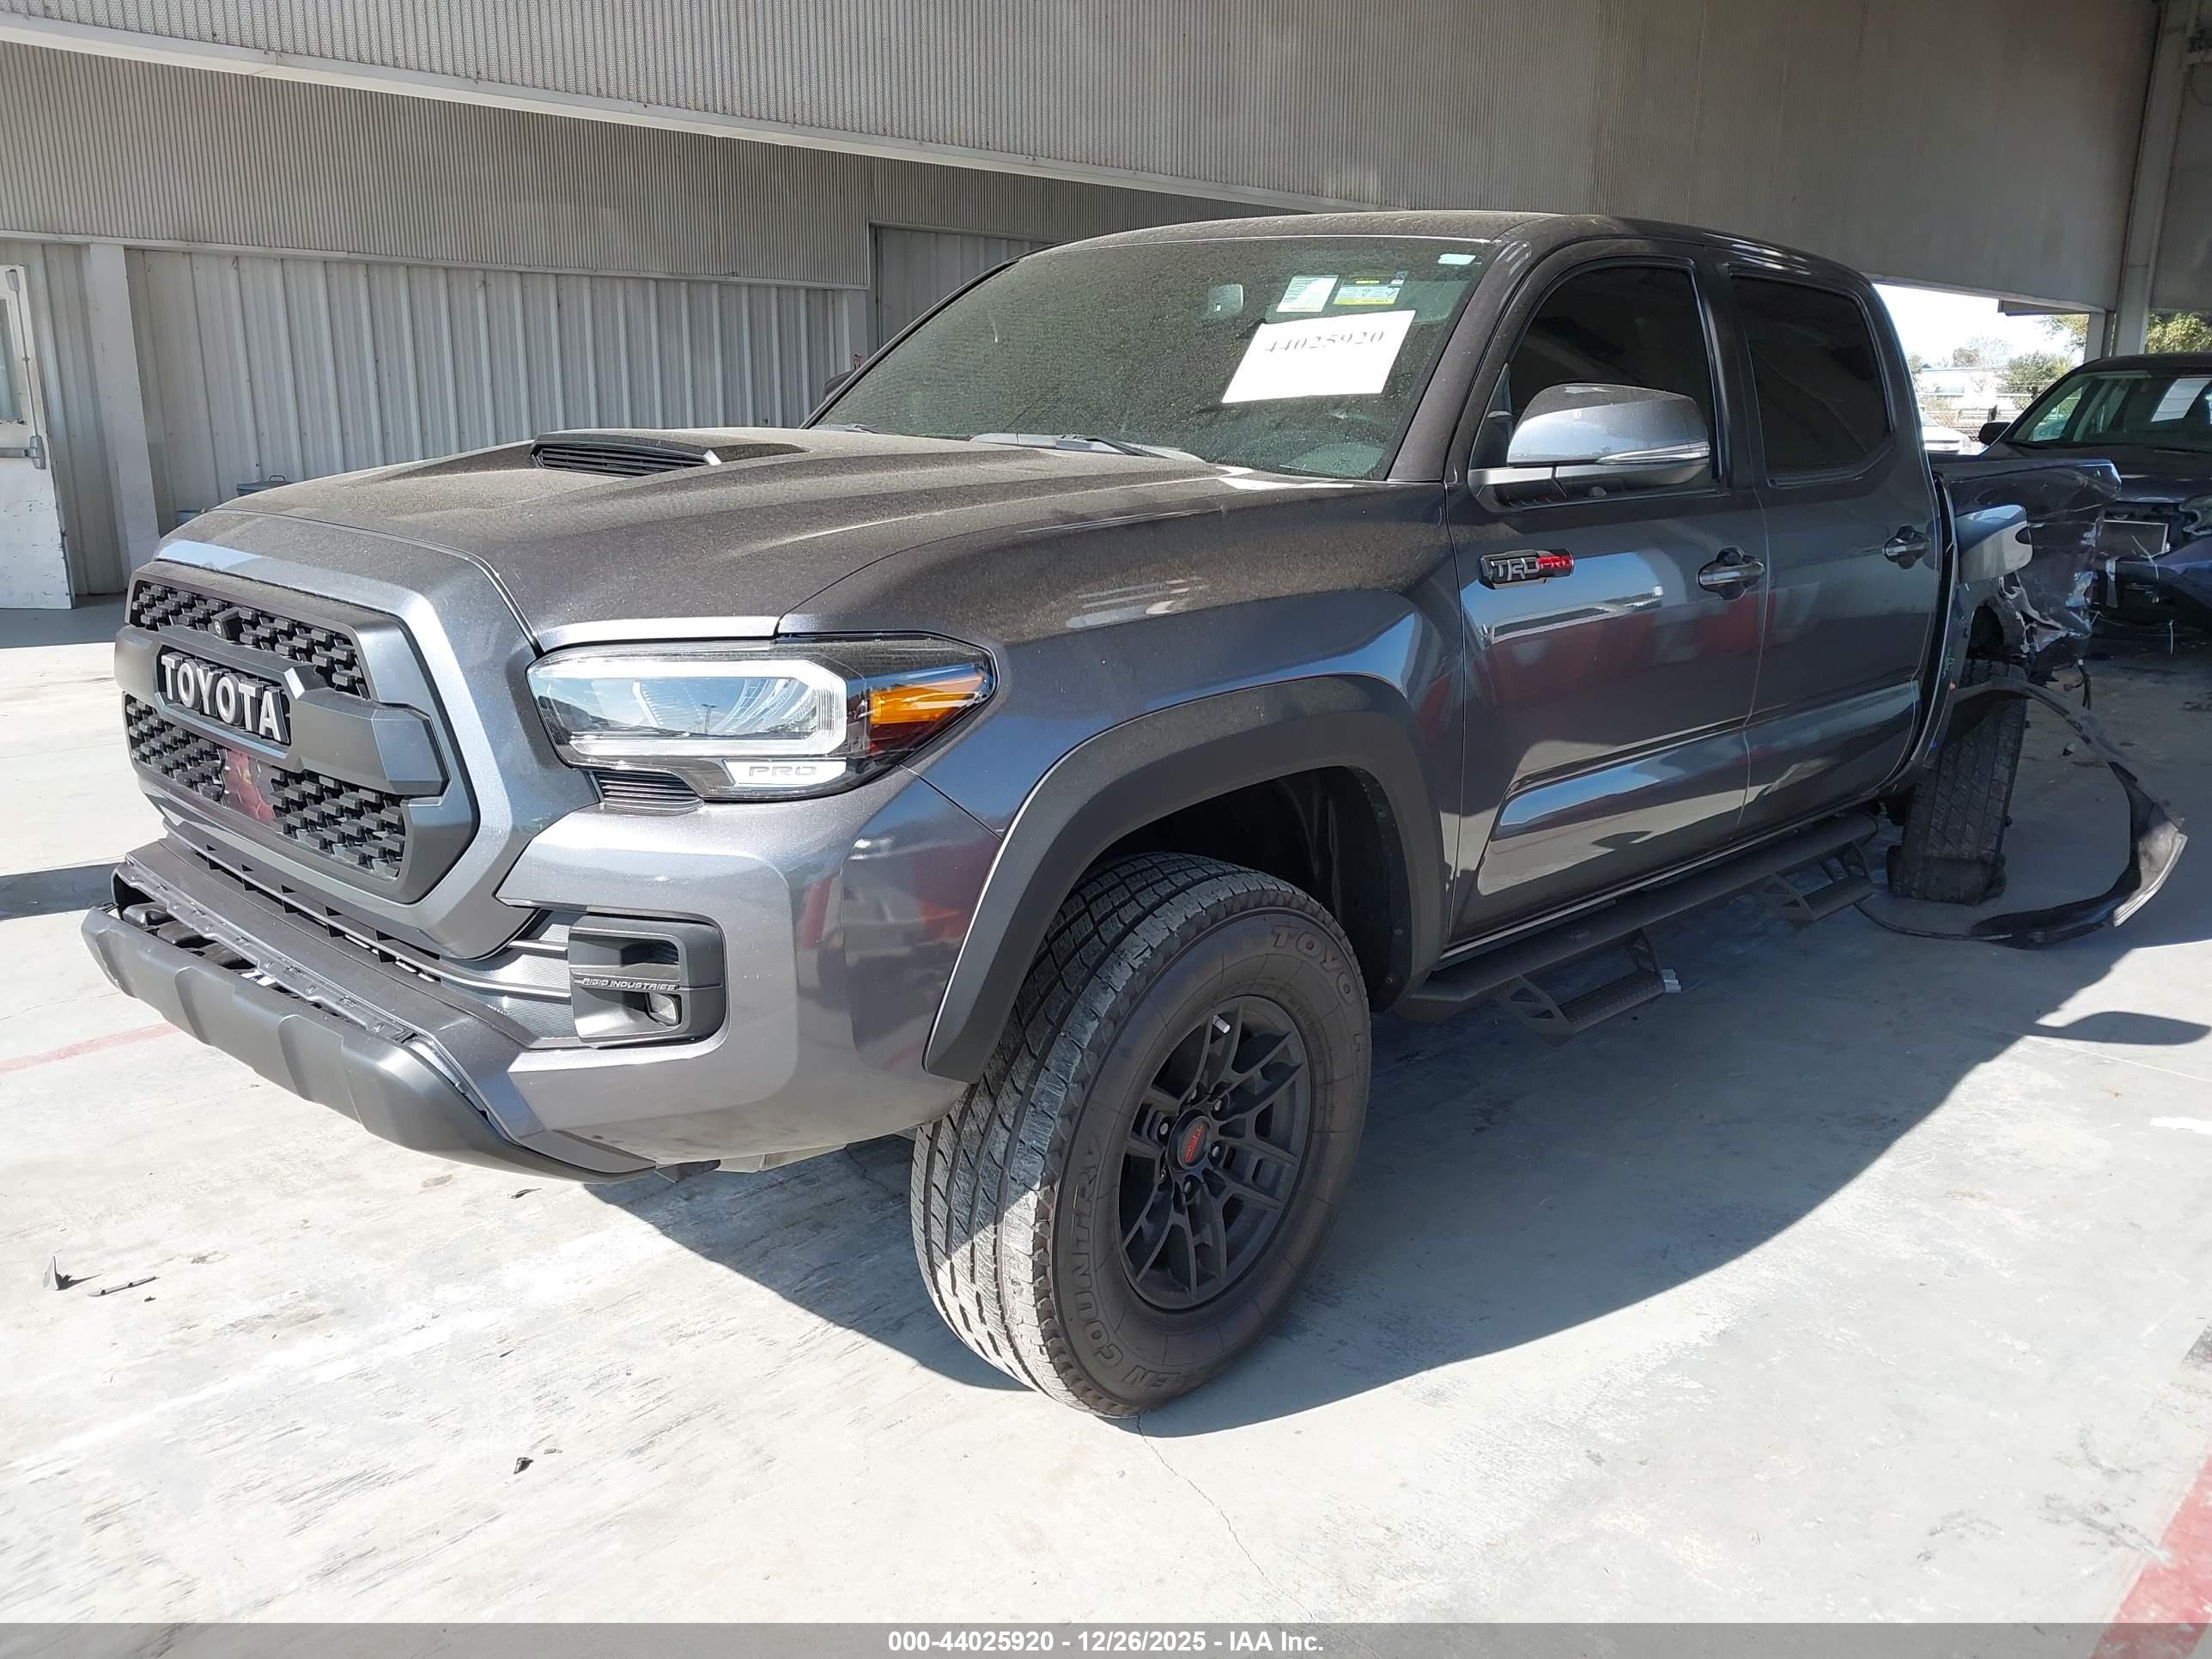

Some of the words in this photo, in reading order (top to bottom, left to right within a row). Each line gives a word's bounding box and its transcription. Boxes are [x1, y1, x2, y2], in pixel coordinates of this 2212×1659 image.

[1263, 330, 1385, 353] 44025920
[1490, 556, 1540, 581] TRD
[161, 653, 285, 743] TOYOTA
[749, 765, 817, 777] PRO
[1271, 924, 1357, 1005] TOYO
[583, 977, 609, 987] RIGID
[609, 980, 677, 991] INDUSTRIES
